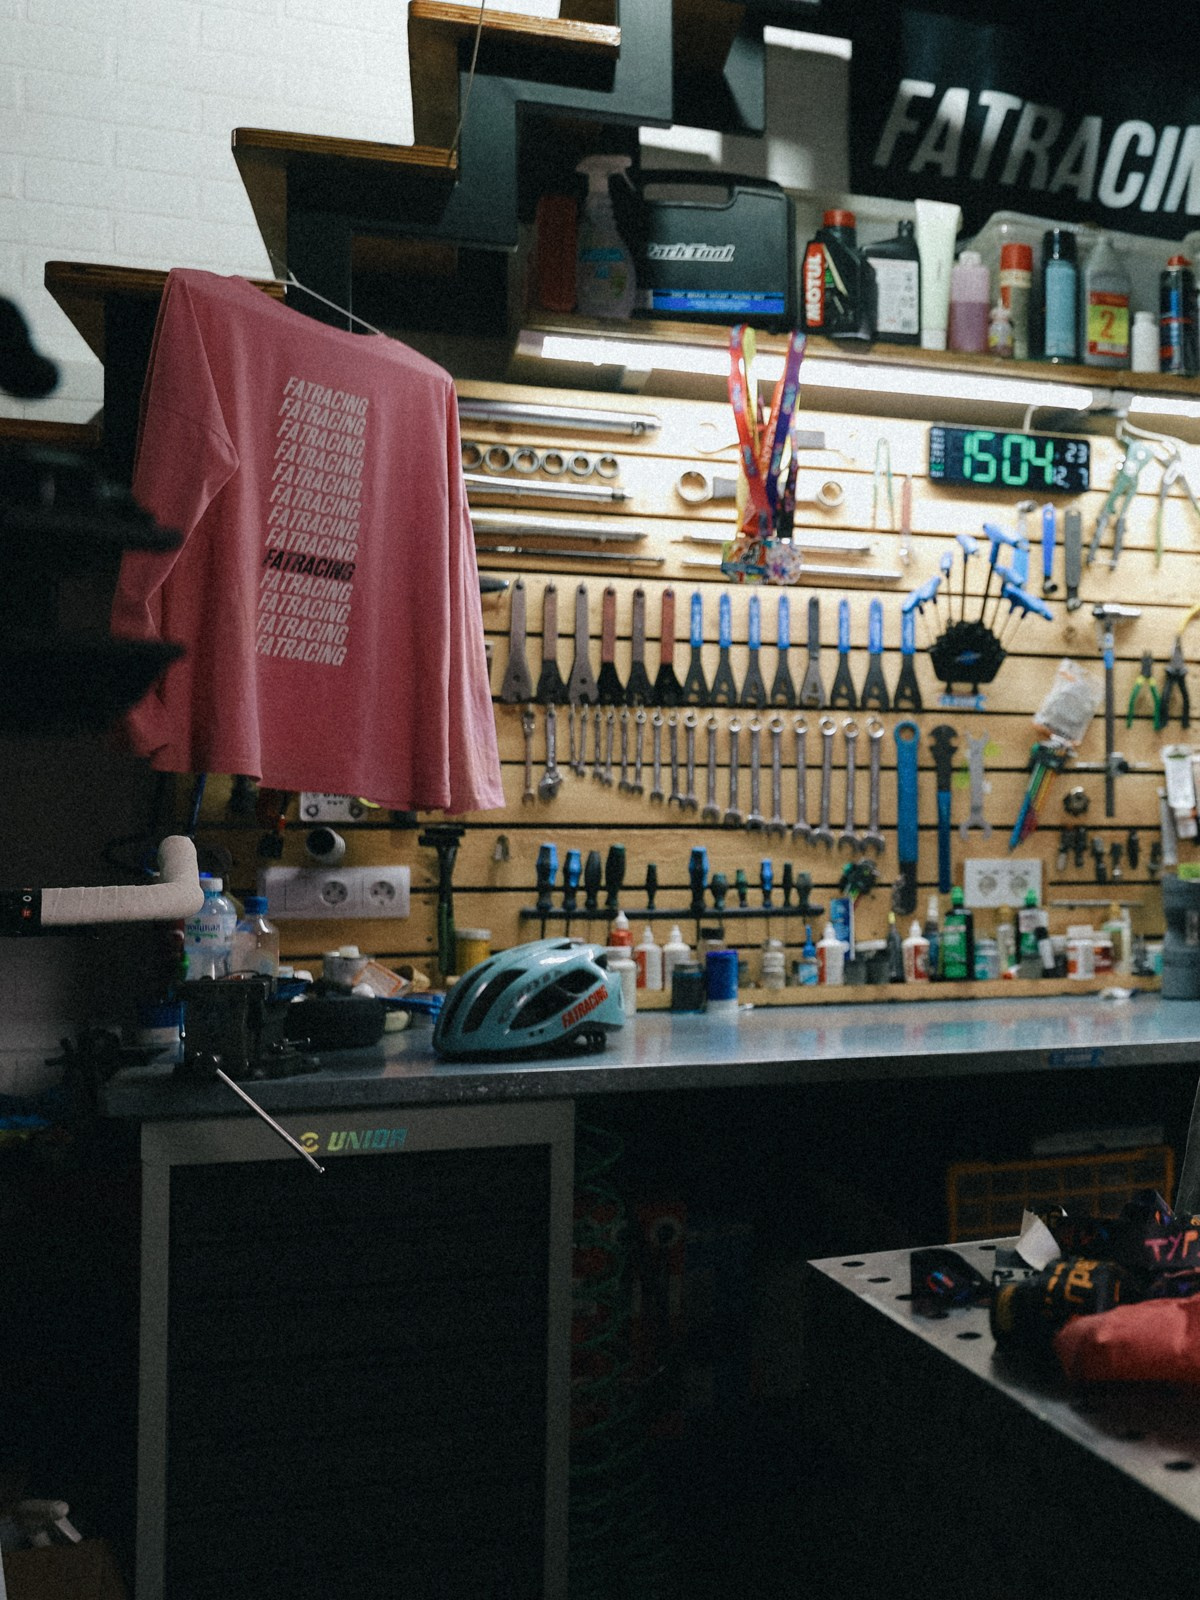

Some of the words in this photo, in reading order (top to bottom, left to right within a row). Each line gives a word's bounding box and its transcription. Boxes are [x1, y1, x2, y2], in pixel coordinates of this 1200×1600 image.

[805, 252, 823, 321] MOTUL
[1101, 309, 1117, 339] 2
[283, 376, 369, 416] FATRACING
[278, 397, 367, 436] FATRACING
[276, 419, 366, 458] FATRACING
[274, 440, 364, 479] FATRACING
[271, 462, 363, 499] FATRACING
[269, 483, 362, 520] FATRACING
[267, 505, 361, 541] FATRACING
[265, 527, 359, 561] FATRACING
[262, 549, 356, 581] FATRACING
[260, 569, 354, 602] FATRACING
[258, 591, 352, 624] FATRACING
[257, 613, 350, 645] FATRACING
[256, 634, 348, 667] FATRACING
[562, 984, 608, 1029] FATRACING
